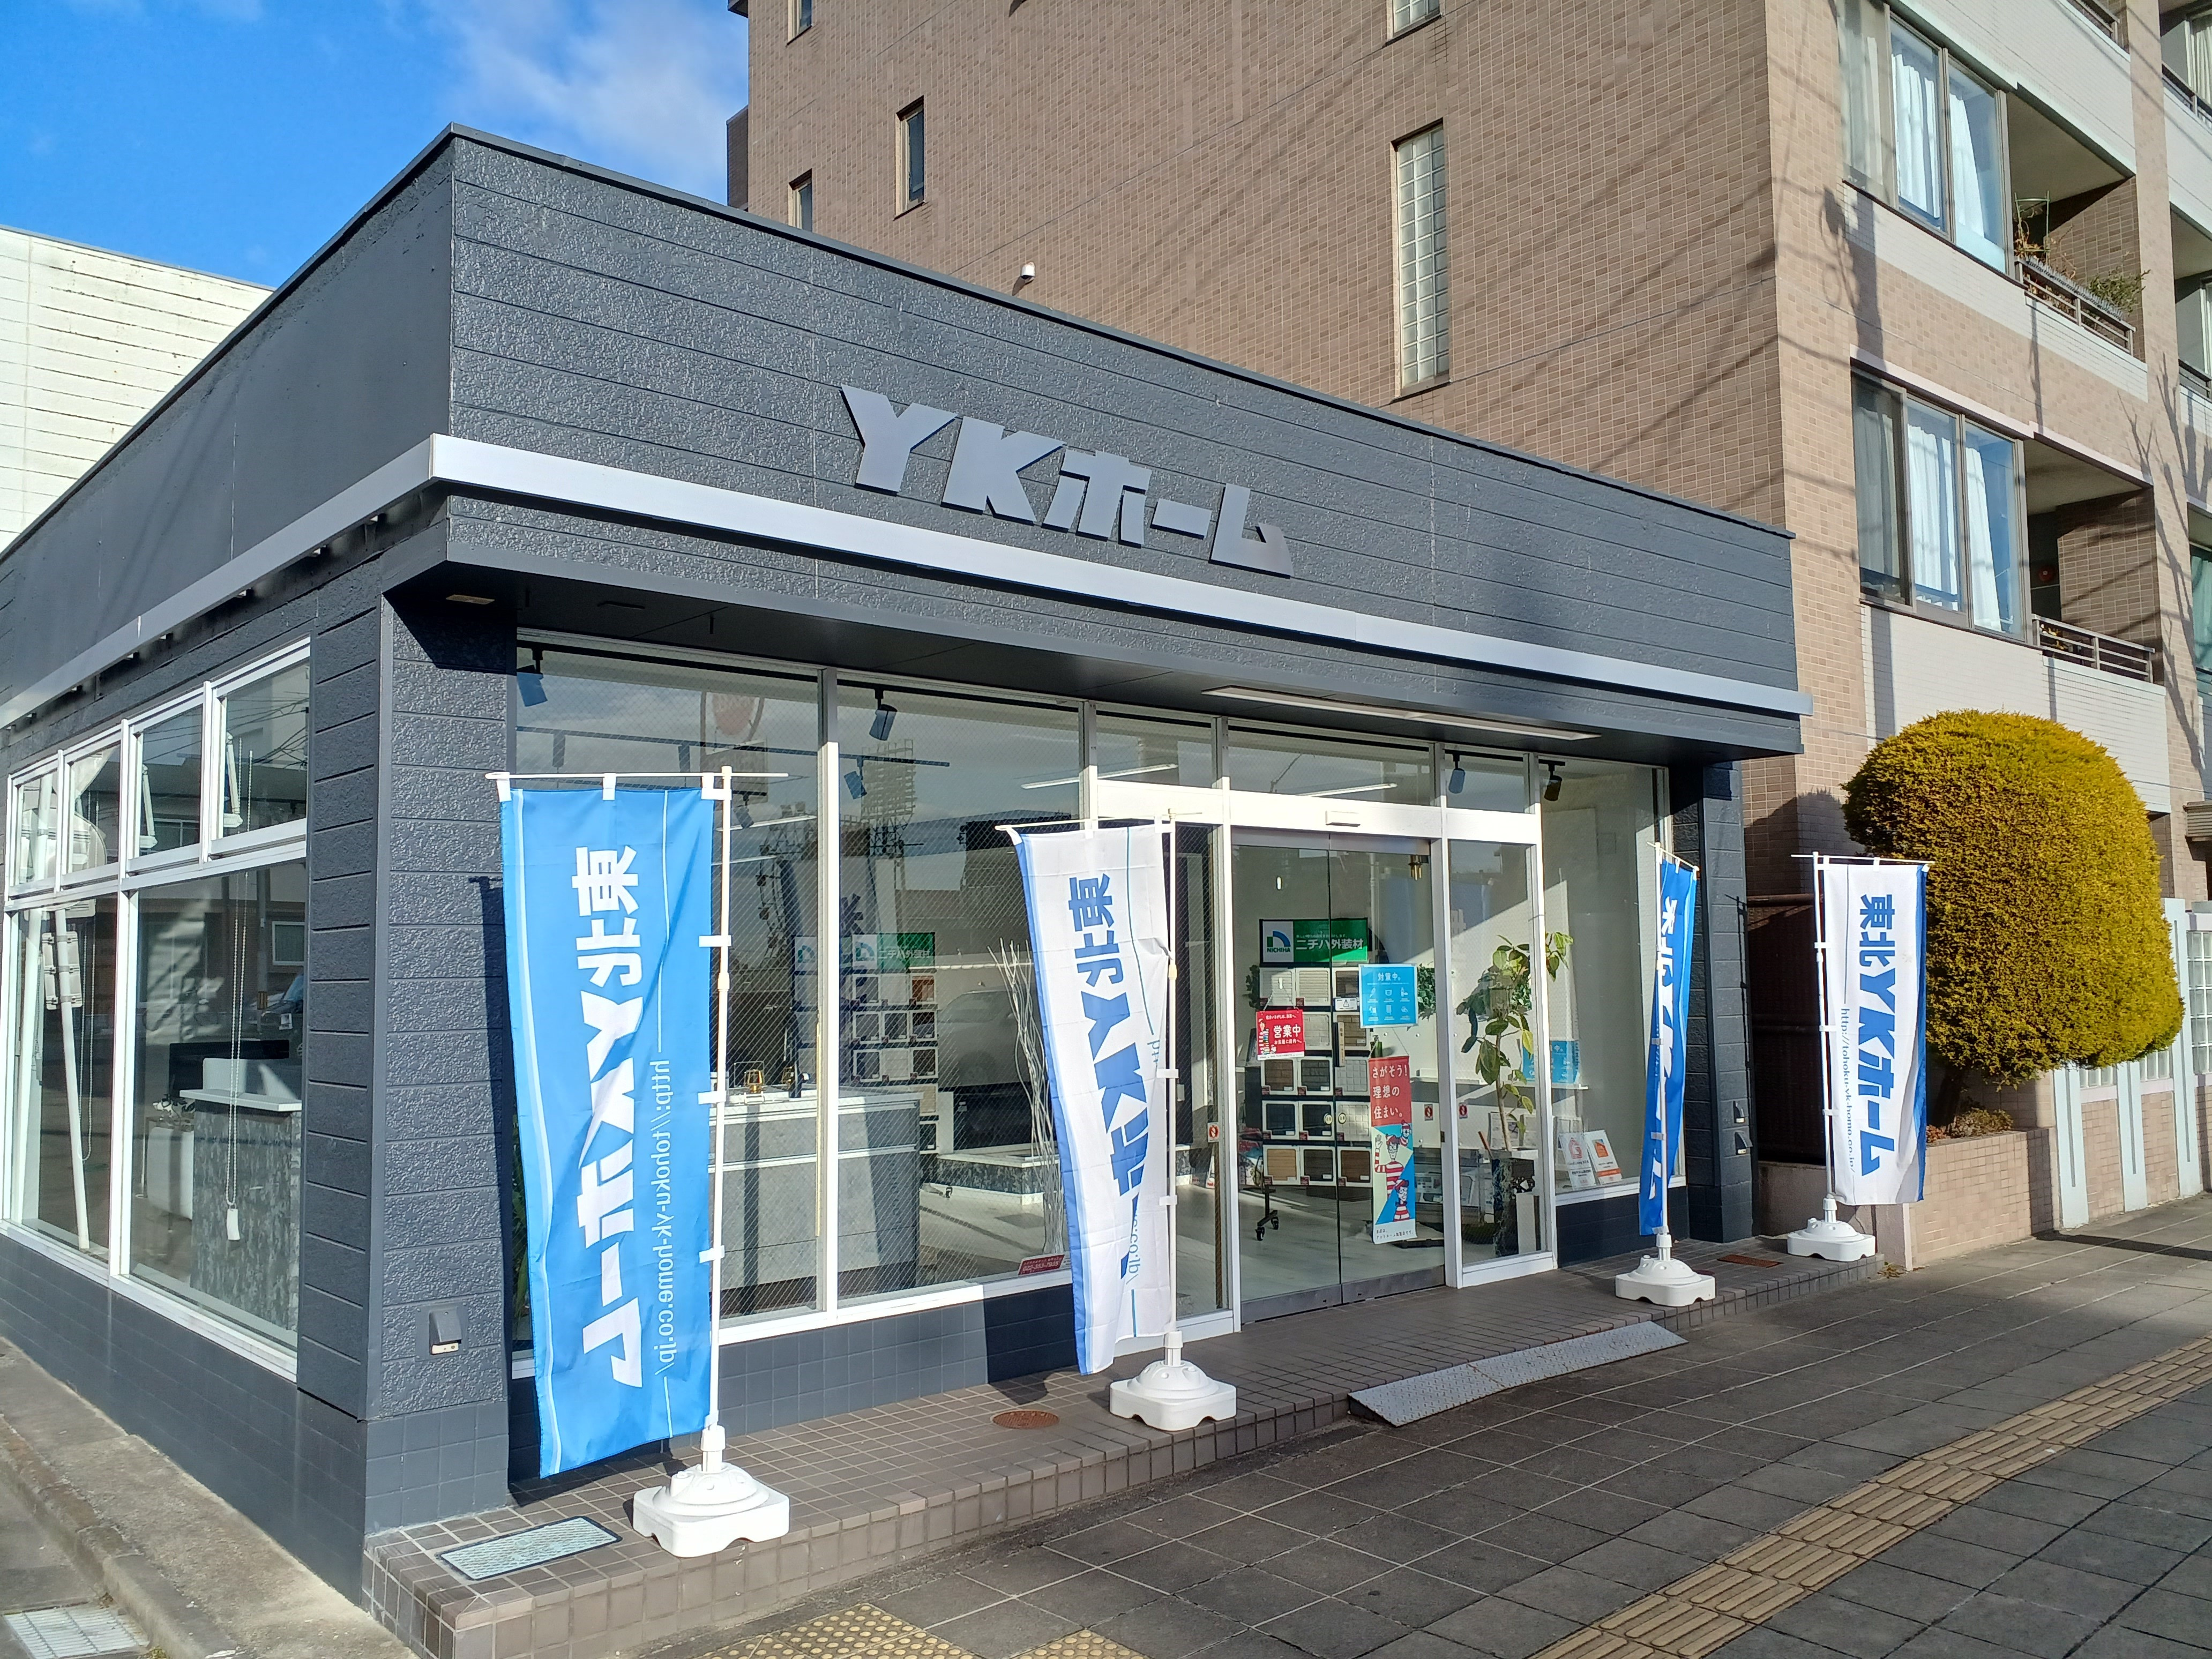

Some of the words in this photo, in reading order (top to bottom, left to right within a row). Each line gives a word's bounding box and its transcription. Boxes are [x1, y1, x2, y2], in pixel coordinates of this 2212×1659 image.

[841, 384, 1294, 579] YKホーム
[1296, 938, 1364, 950] ニチハ外装材
[1273, 1023, 1301, 1038] 営業中
[1858, 894, 1895, 1176] 東北YKホーム
[1372, 1085, 1400, 1098] 理想の
[1373, 1105, 1402, 1119] 住まい。
